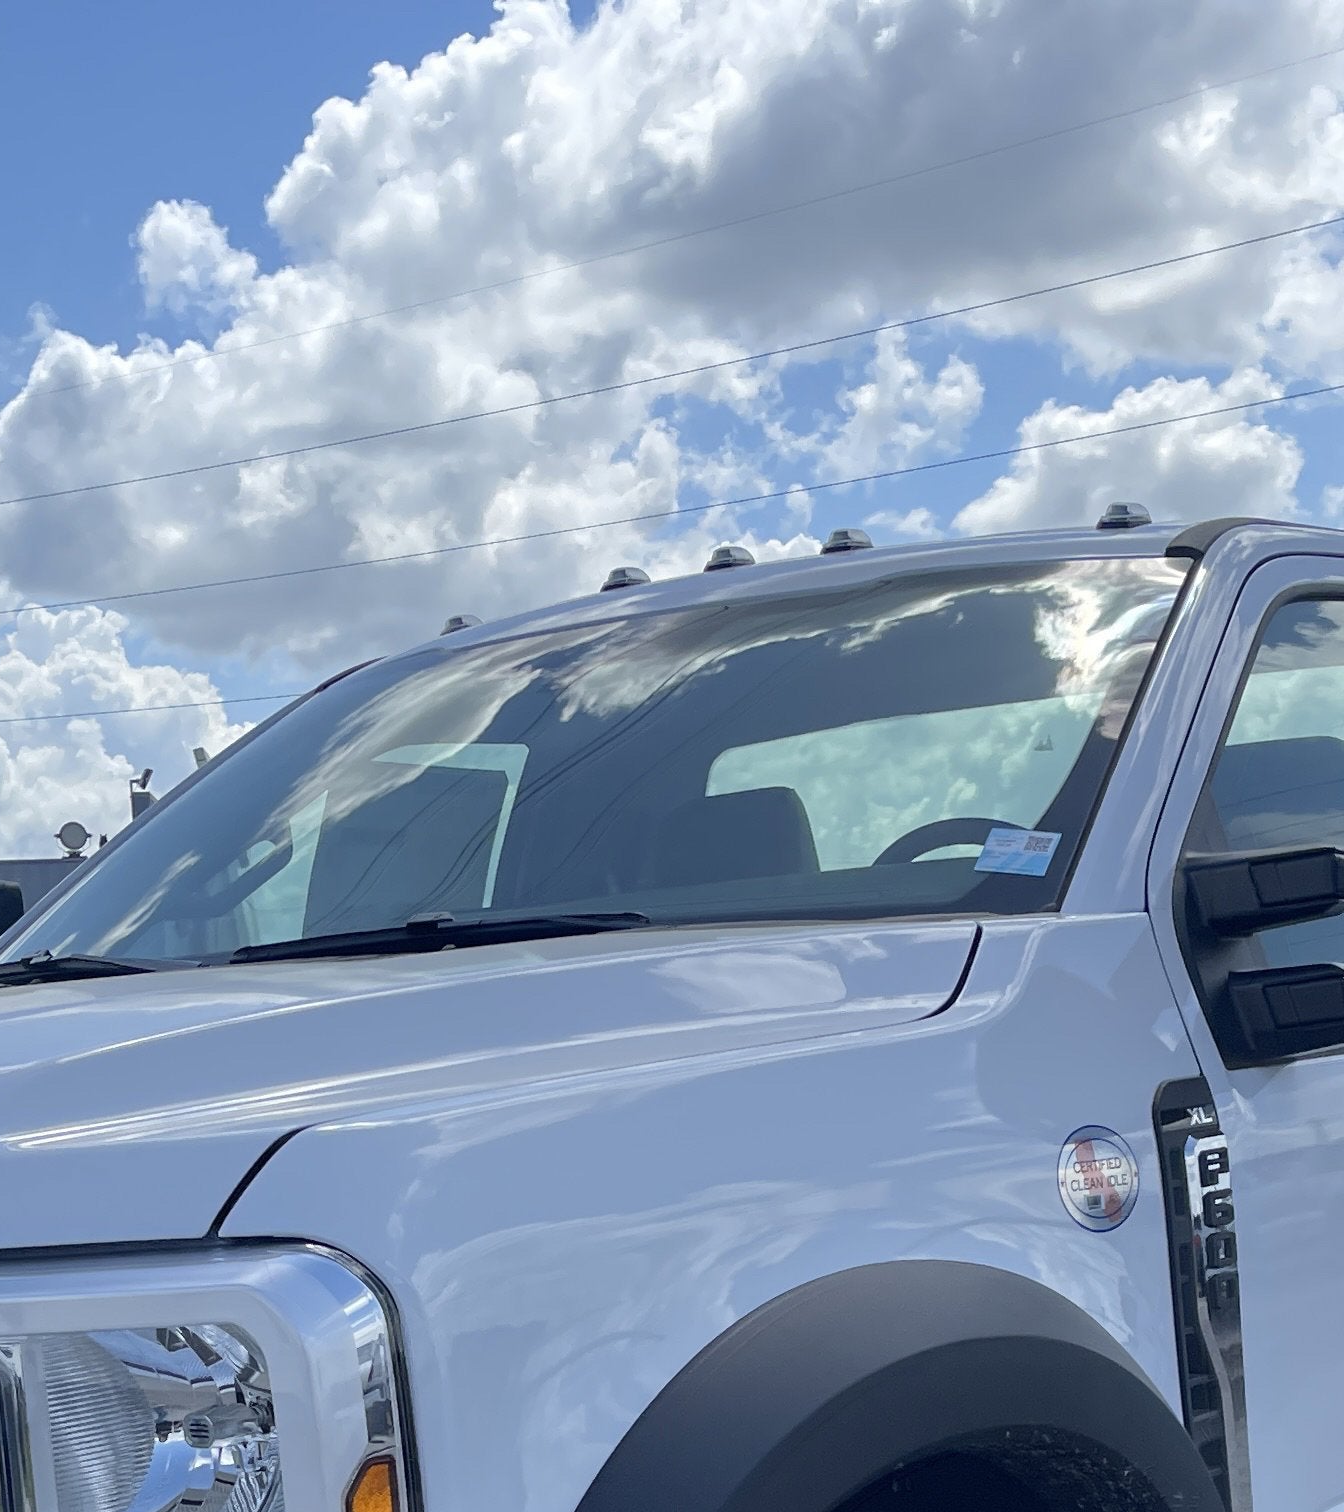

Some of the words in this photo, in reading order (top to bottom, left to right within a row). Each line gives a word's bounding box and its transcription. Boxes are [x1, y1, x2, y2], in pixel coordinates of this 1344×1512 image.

[1186, 1106, 1213, 1126] XL
[1072, 1156, 1122, 1174] CERTIFIED
[1070, 1177, 1104, 1192] CLEAN
[1107, 1173, 1128, 1188] IDLE
